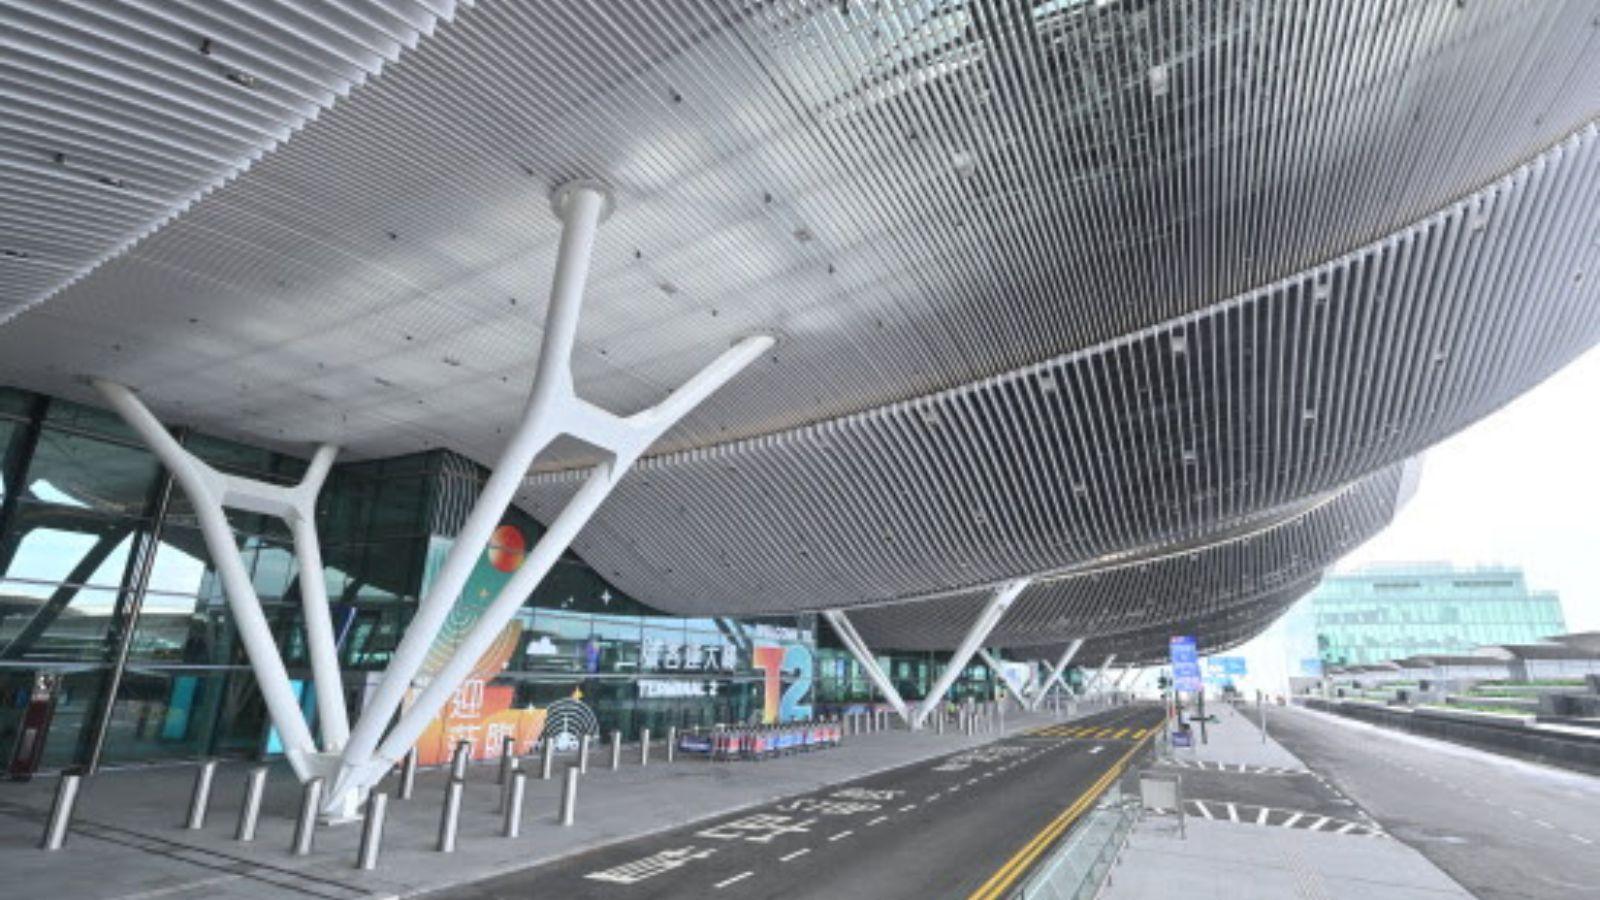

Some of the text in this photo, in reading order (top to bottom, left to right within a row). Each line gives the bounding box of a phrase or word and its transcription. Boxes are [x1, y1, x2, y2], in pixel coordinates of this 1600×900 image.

[637, 680, 719, 697] TERMINAL 2
[753, 644, 813, 724] T2
